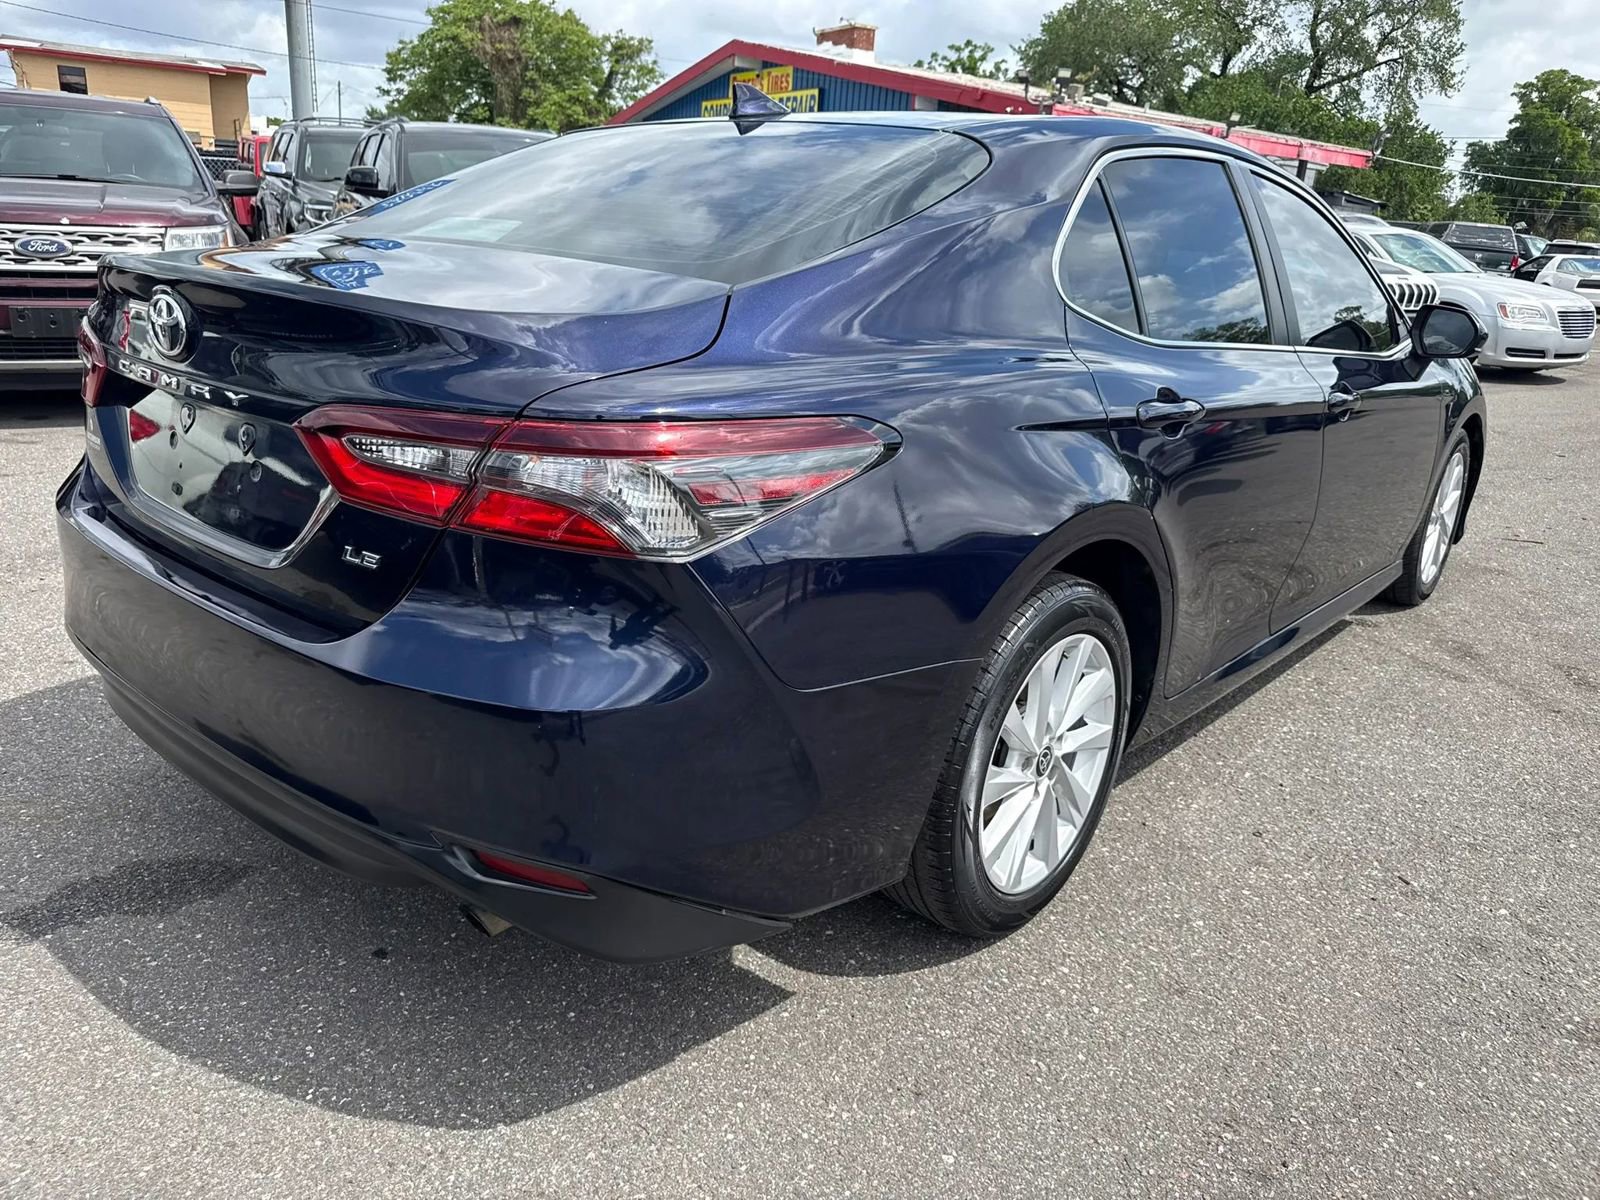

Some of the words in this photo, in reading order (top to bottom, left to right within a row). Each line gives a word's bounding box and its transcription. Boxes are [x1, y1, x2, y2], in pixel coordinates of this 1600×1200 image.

[767, 71, 790, 93] TIRES
[28, 240, 58, 251] Ford
[118, 358, 249, 407] CAMRY
[341, 545, 381, 569] LE
